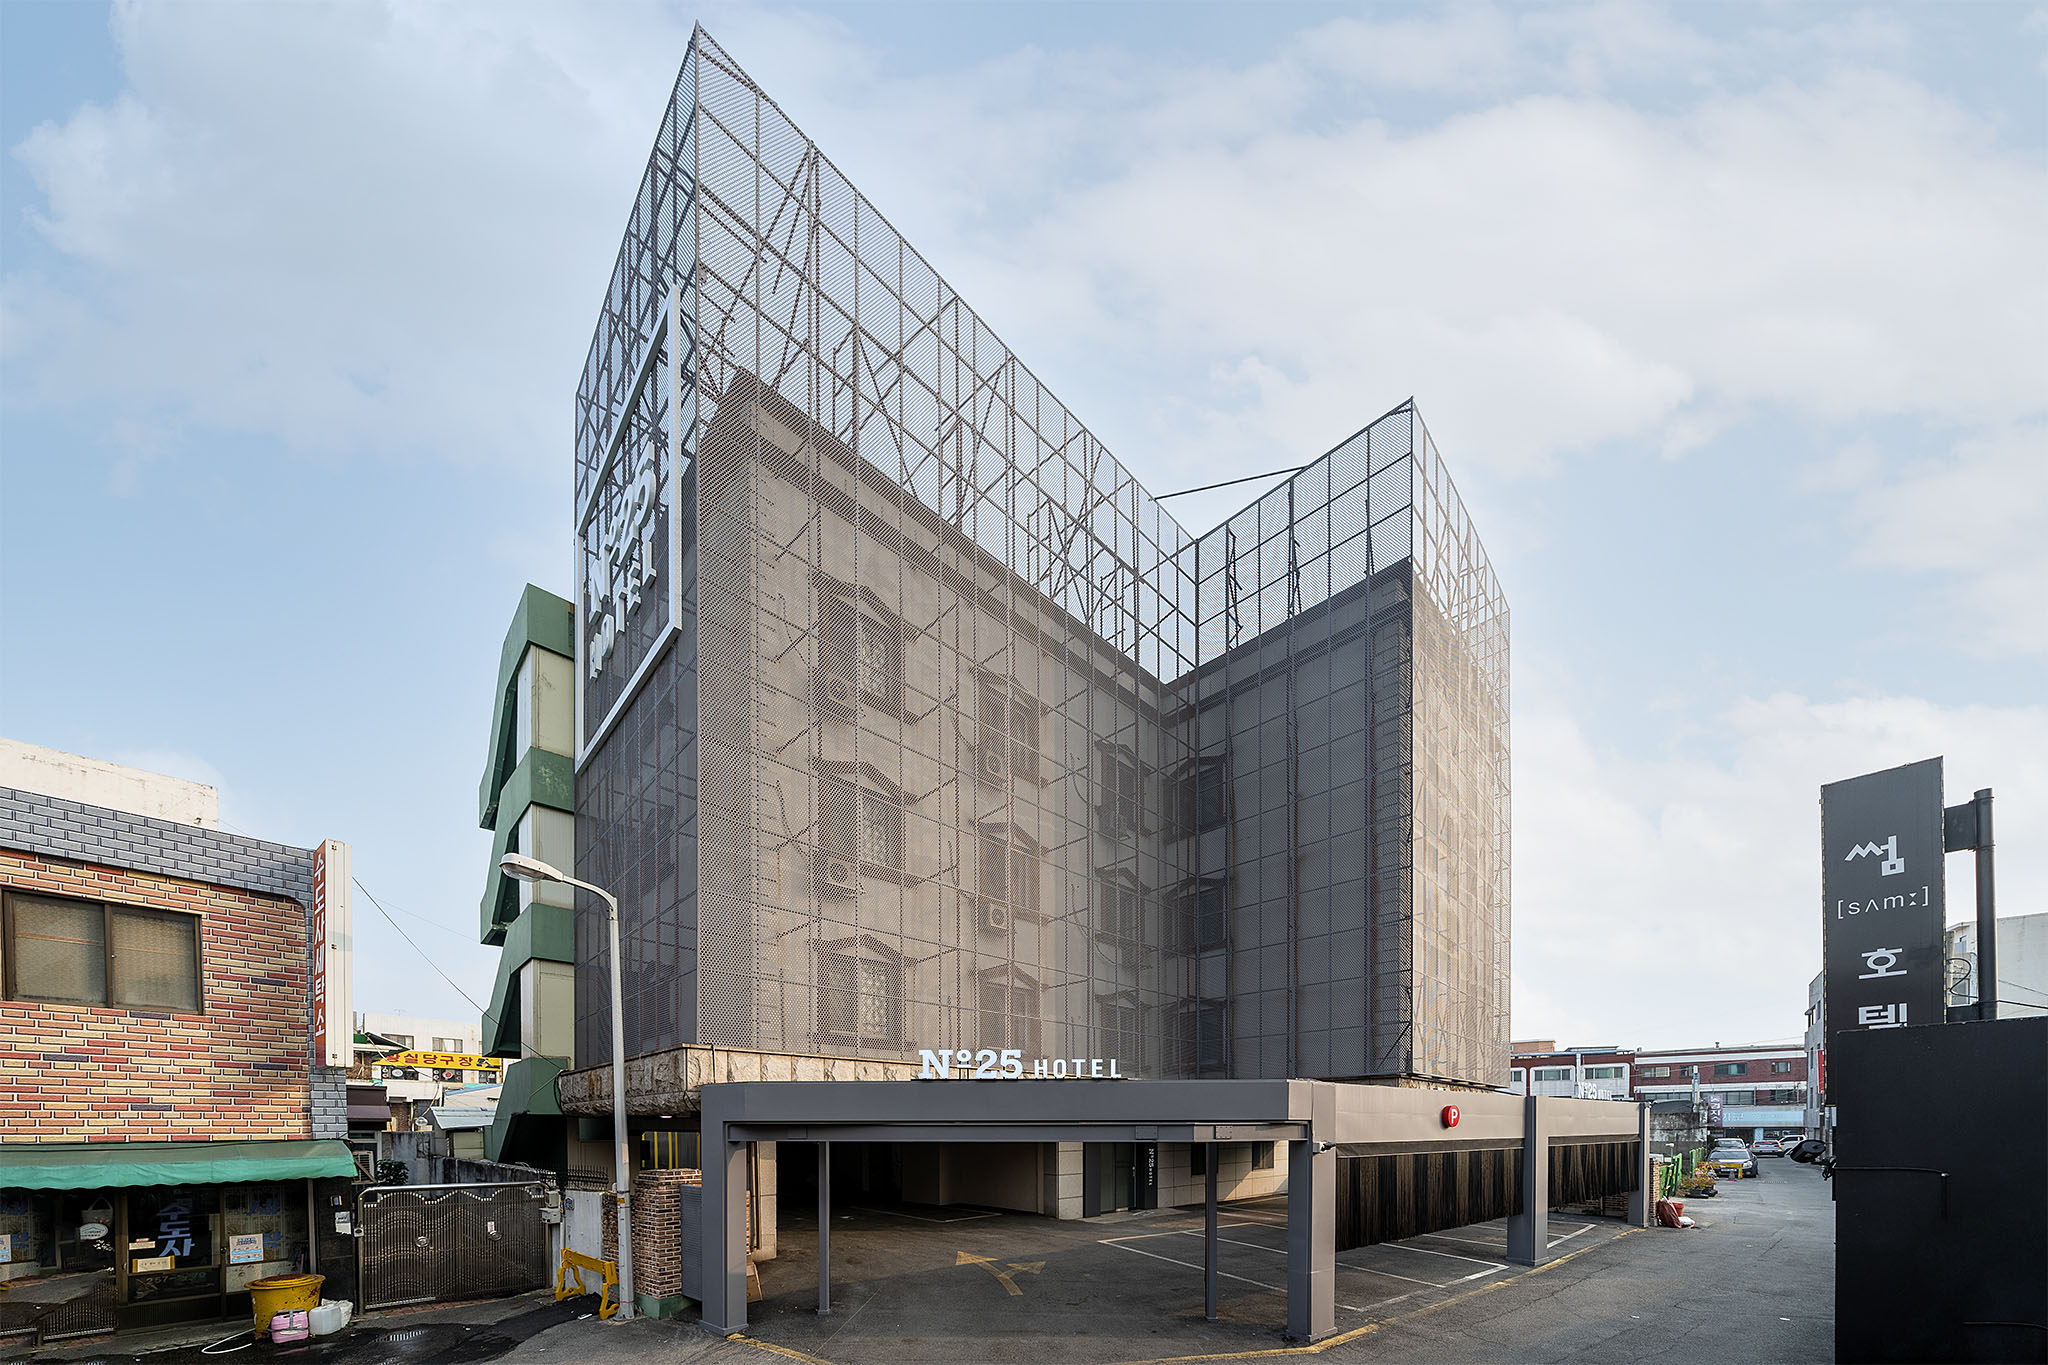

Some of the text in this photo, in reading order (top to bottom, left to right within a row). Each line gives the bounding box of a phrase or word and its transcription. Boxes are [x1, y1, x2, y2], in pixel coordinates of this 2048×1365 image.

[589, 536, 657, 681] HOTEL
[1844, 835, 1905, 877] 썸
[1034, 1058, 1122, 1079] HOTEL
[1451, 1108, 1458, 1124] P
[156, 1202, 195, 1257] 수도사
